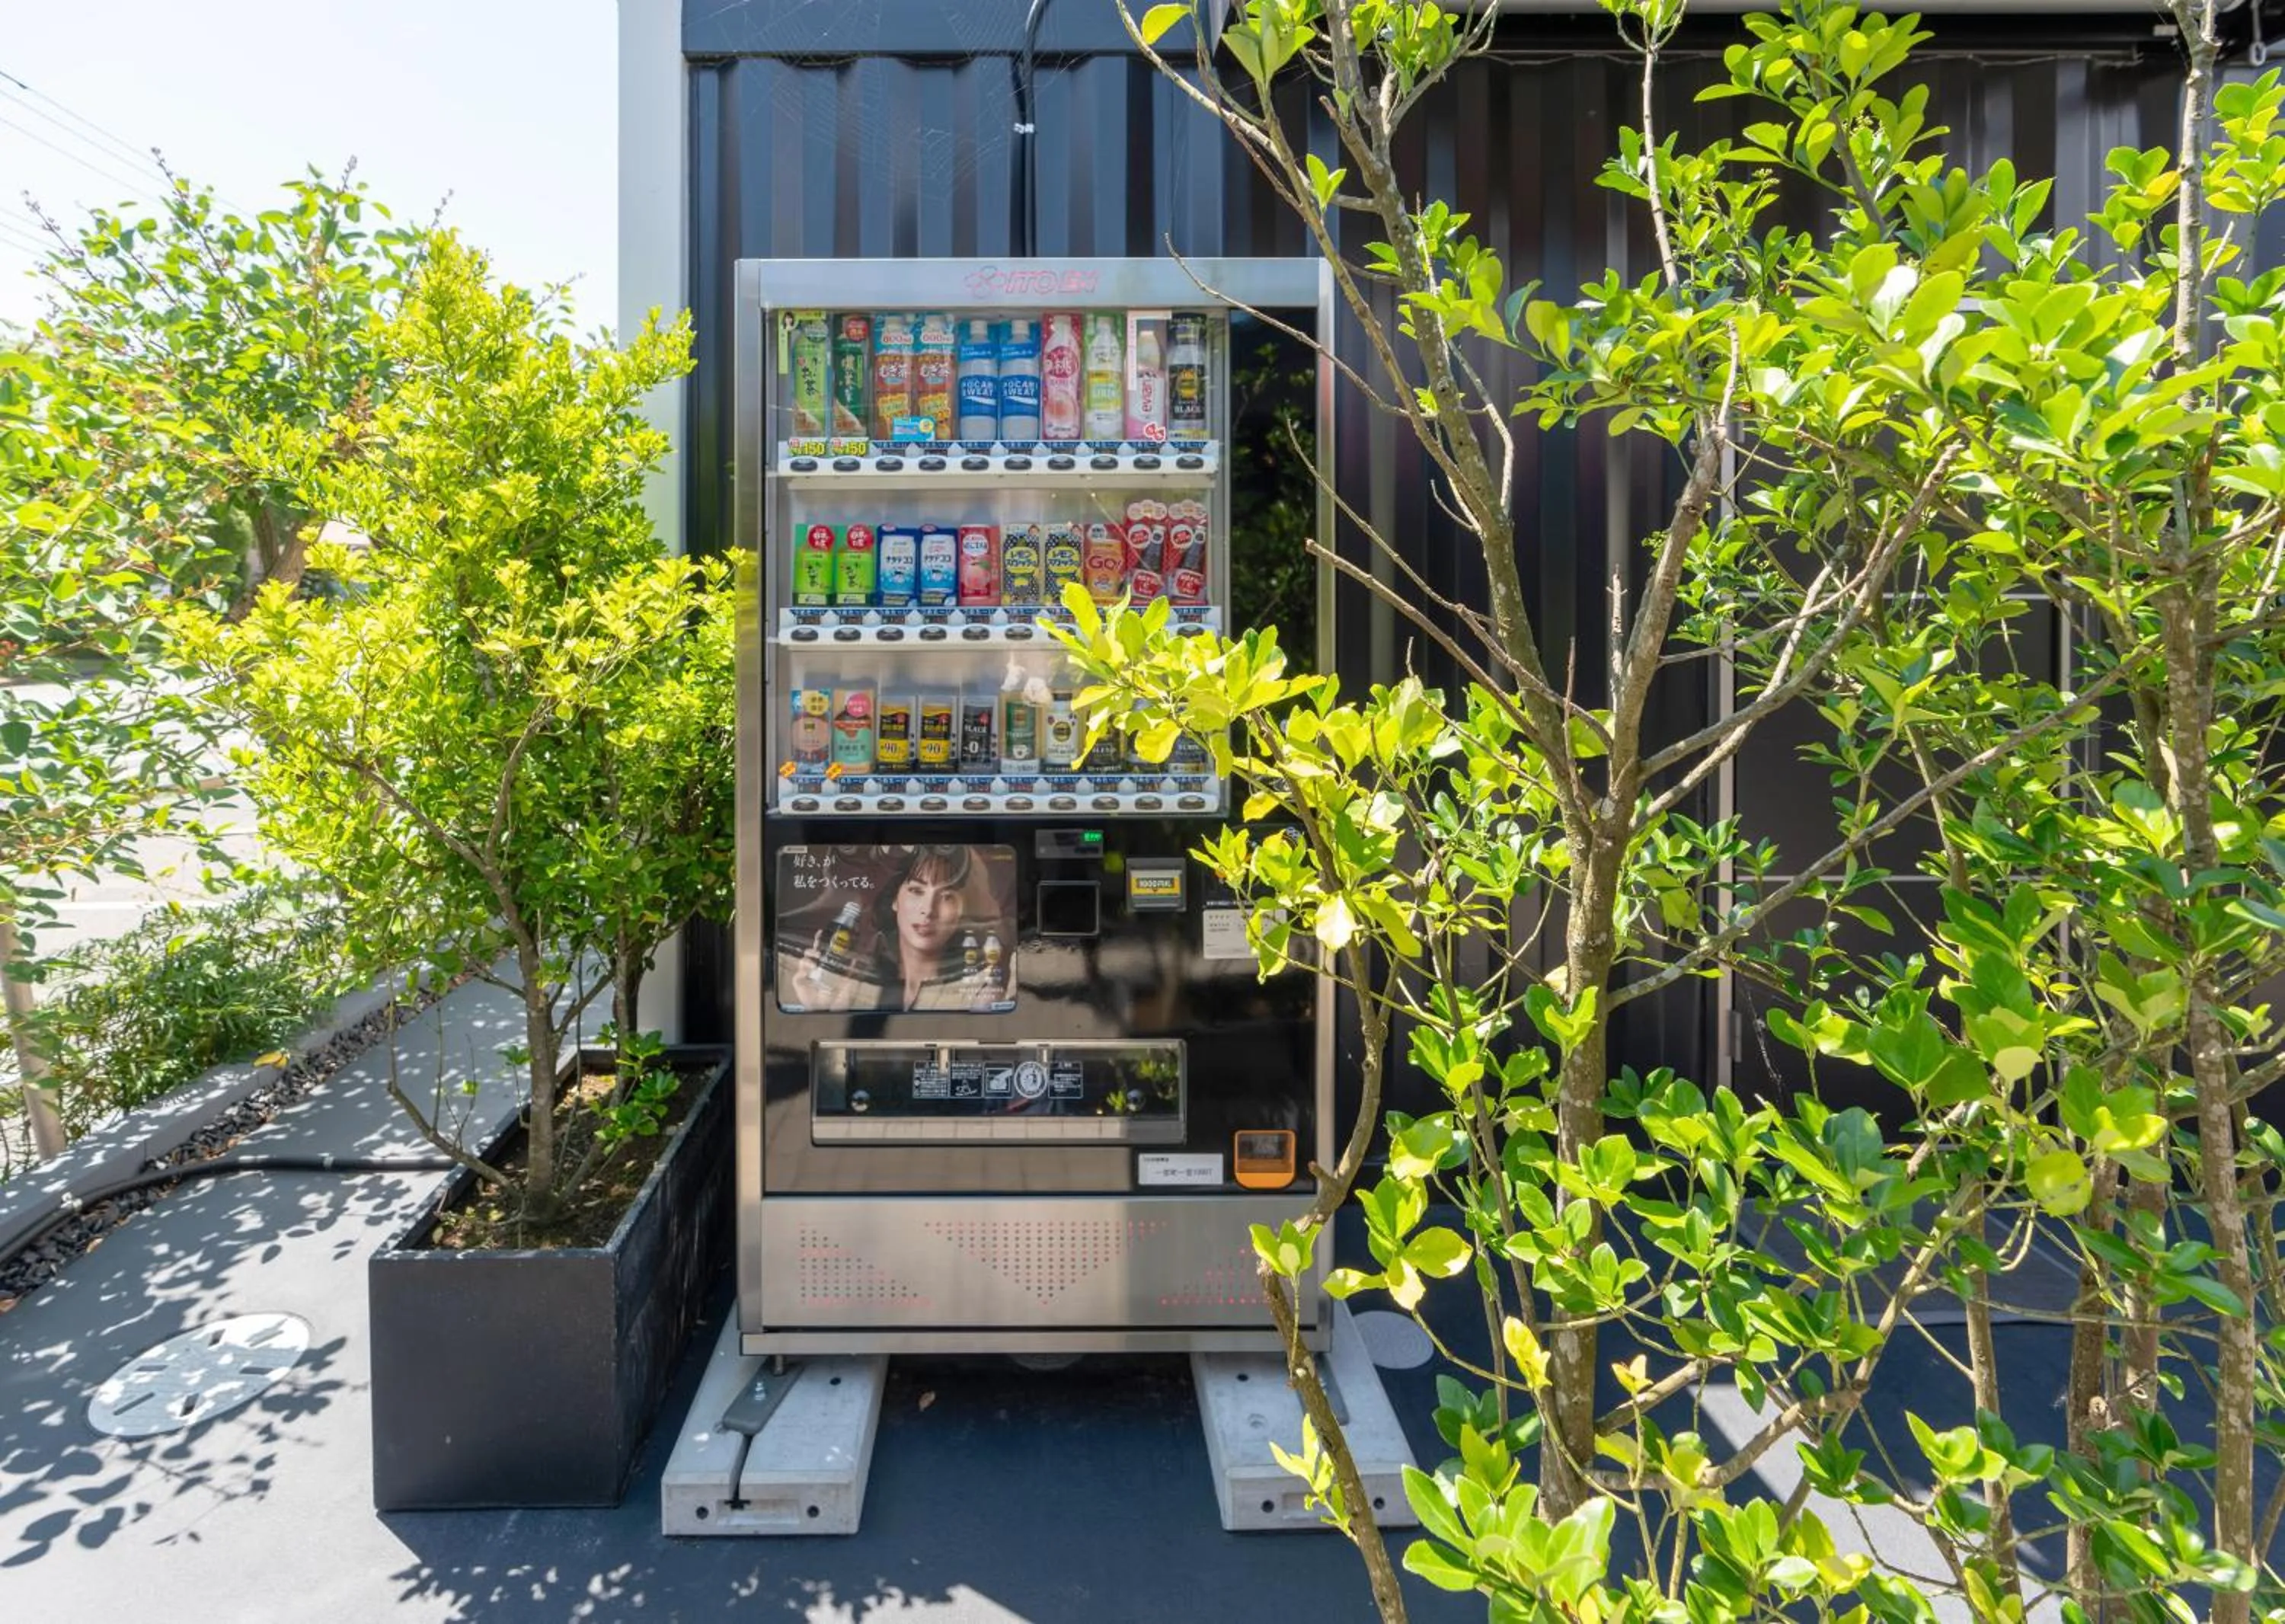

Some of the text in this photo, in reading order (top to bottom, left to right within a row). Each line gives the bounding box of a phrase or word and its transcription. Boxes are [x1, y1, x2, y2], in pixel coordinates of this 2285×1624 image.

[794, 874, 875, 889] 私をつくってる。
